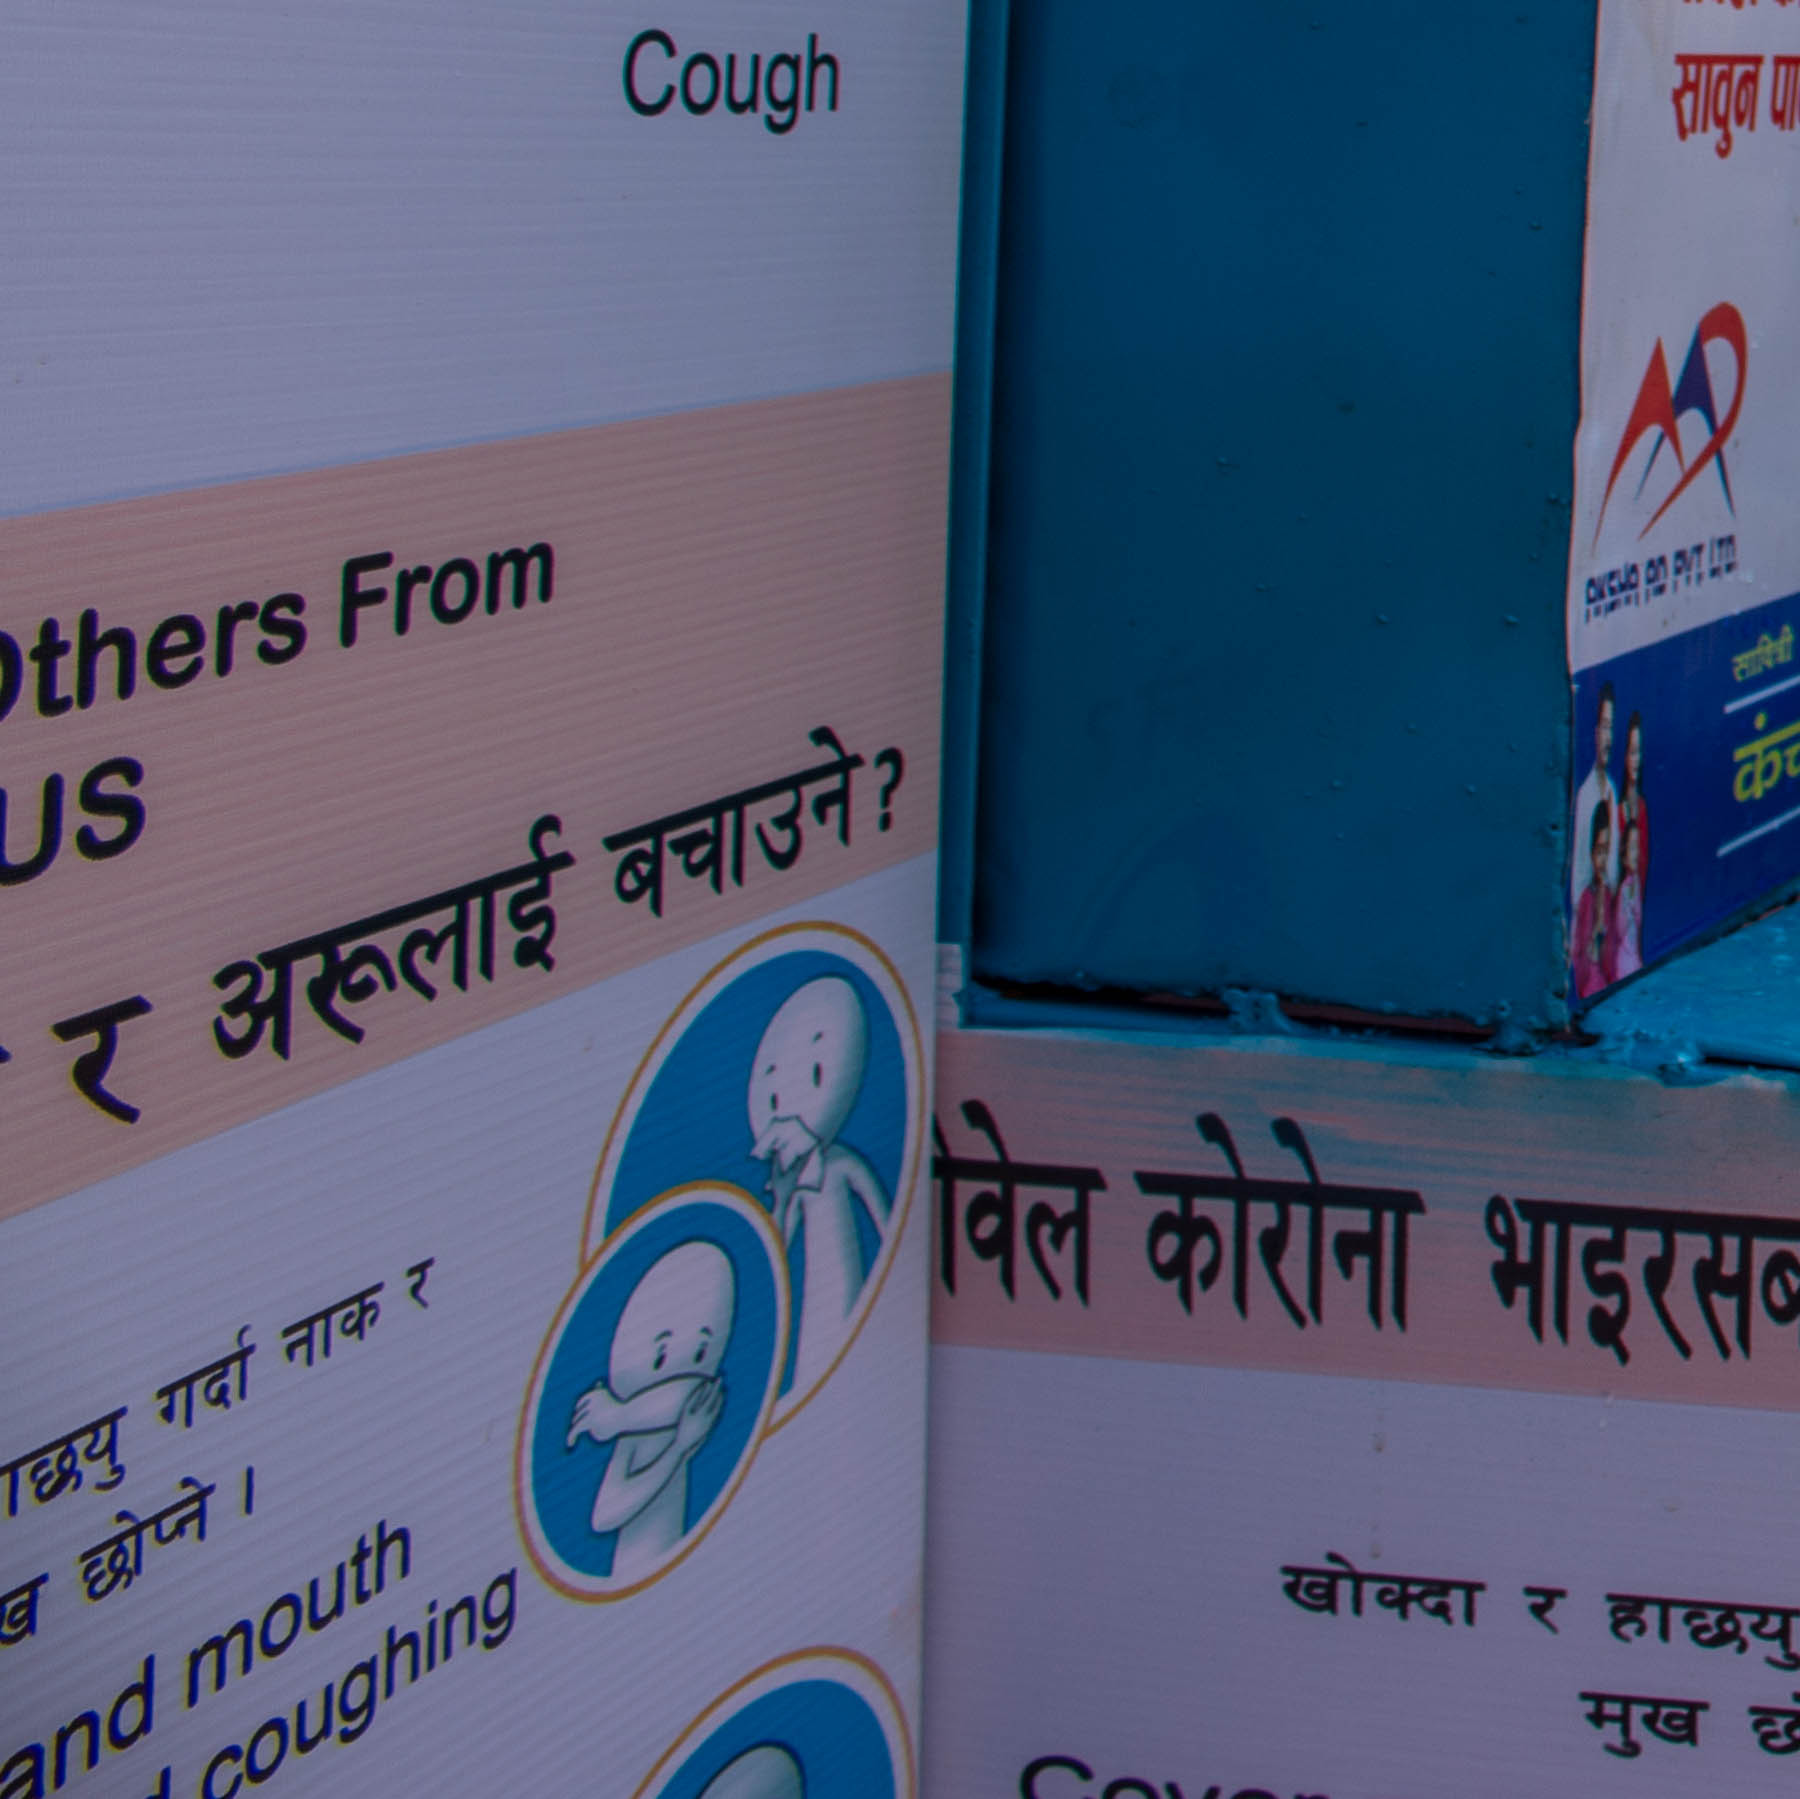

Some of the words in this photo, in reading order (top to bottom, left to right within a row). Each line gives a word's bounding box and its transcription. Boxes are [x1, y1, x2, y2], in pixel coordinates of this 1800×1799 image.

[622, 28, 840, 135] Cough
[339, 541, 556, 648] From
[0, 756, 147, 887] US
[51, 994, 153, 1124] र
[211, 814, 577, 1062] अरूलाई
[1133, 1111, 1426, 1332] कोरोना
[156, 1324, 256, 1430] गर्दा
[280, 1280, 386, 1369] नाक
[406, 1257, 436, 1308] र
[0, 1653, 156, 1799] and
[184, 1519, 412, 1709] mouth
[1280, 1551, 1487, 1627] खोक्दा
[1522, 1585, 1568, 1635] र
[200, 1566, 519, 1799] coughing
[1578, 1690, 1711, 1759] मुख
